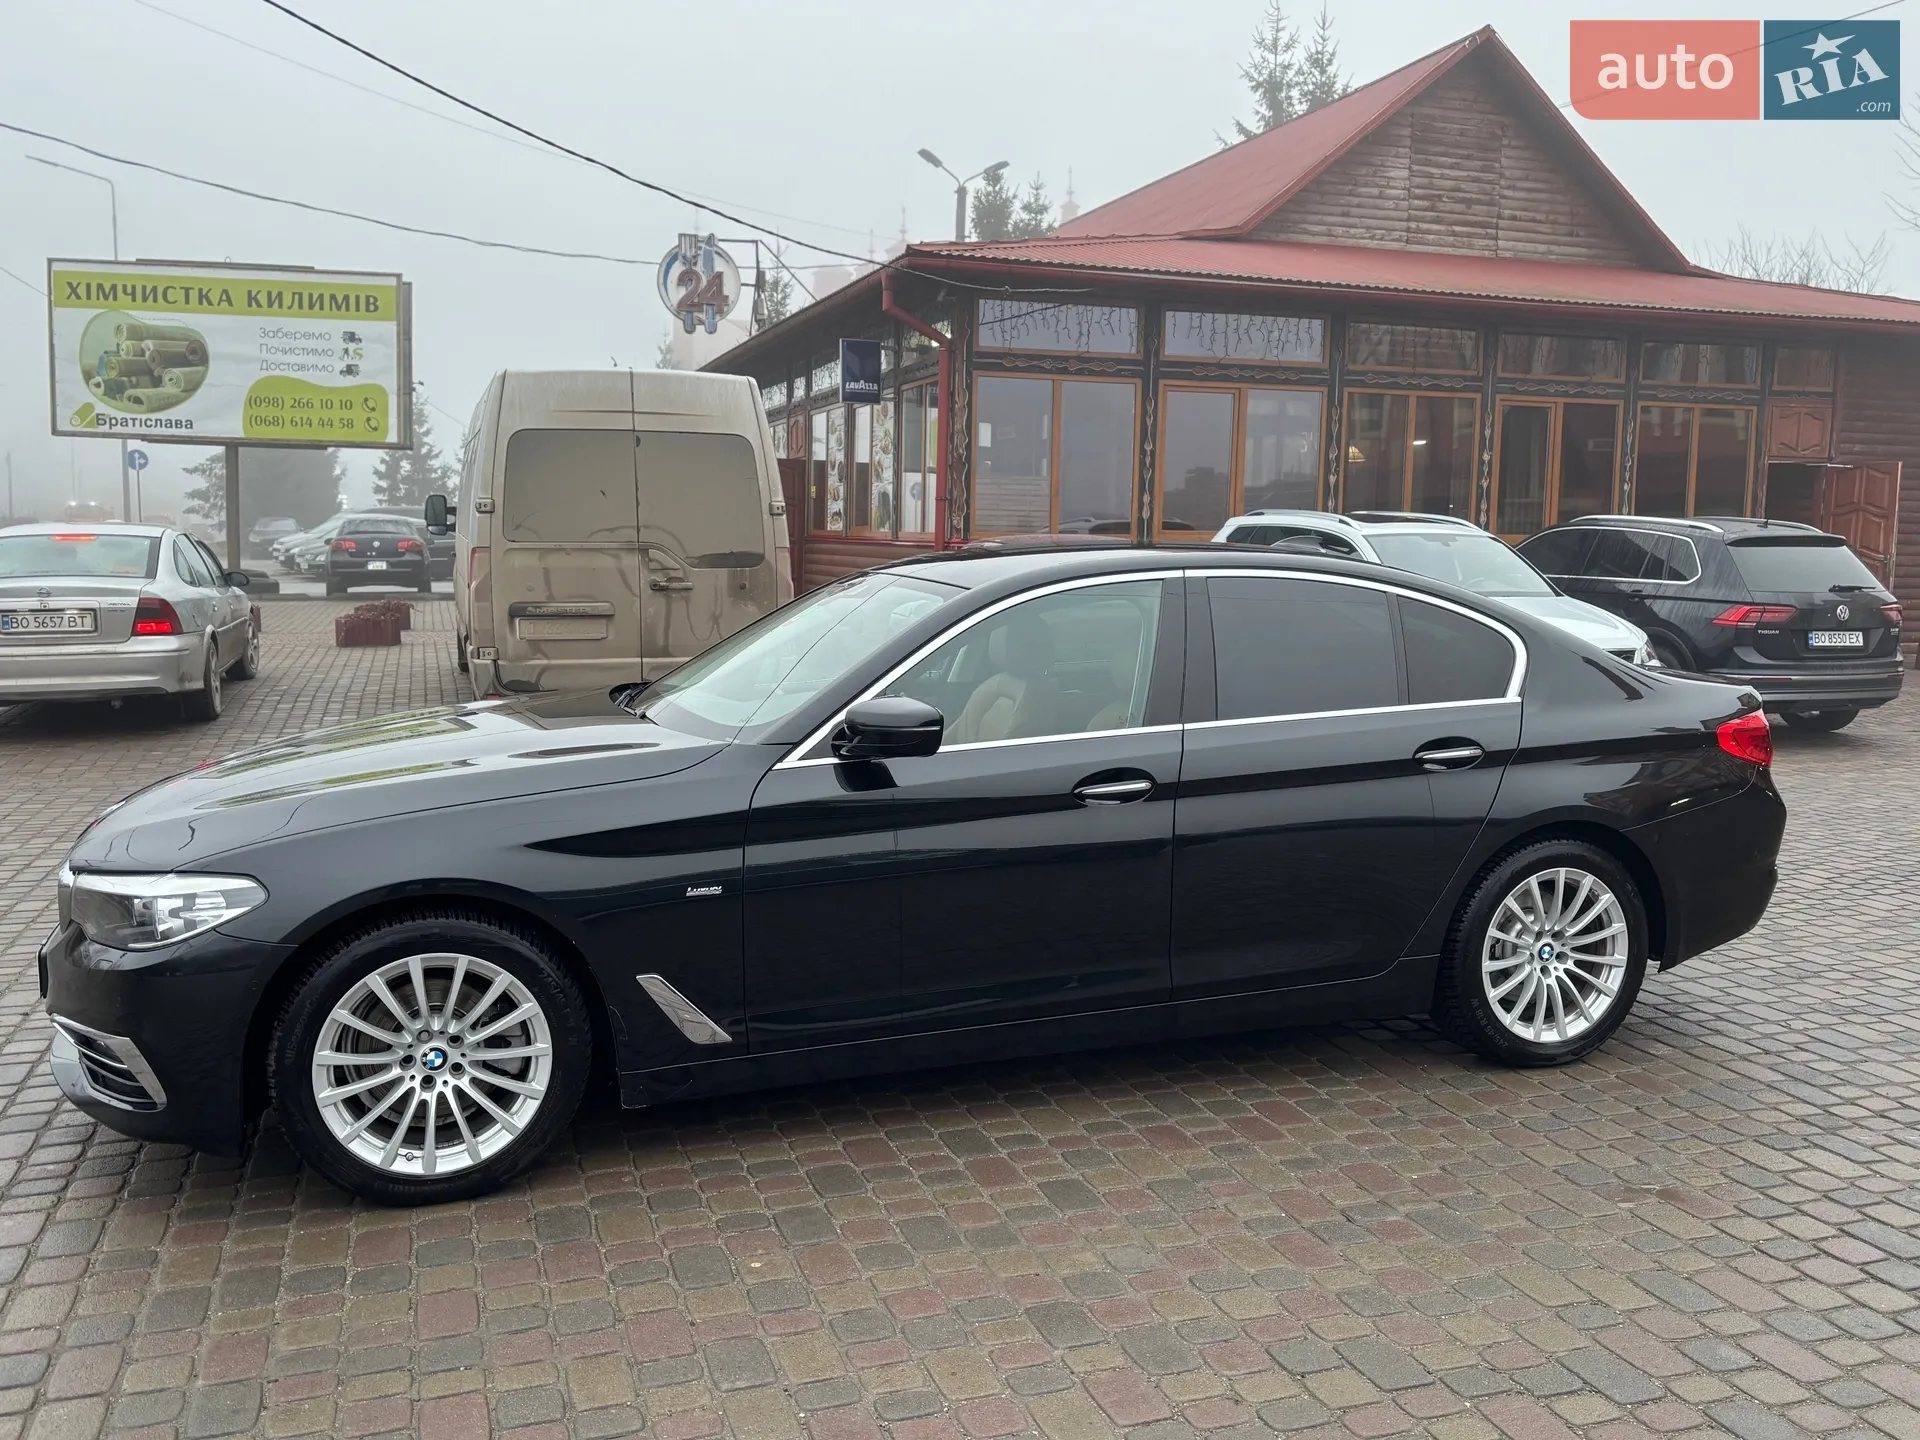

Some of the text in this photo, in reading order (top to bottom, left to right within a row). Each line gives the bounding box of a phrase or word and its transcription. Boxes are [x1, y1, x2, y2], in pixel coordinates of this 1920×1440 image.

[65, 280, 380, 314] ХІМЧИСТКА КИЛИМІВ
[676, 268, 730, 315] 24
[258, 326, 332, 342] Заберемо
[259, 342, 335, 358] Почистимо
[259, 359, 335, 374] Доставимо
[845, 379, 878, 390] LAVAZZA
[248, 394, 354, 411] (098) 266 10 10
[95, 412, 195, 431] Братіслава
[248, 413, 355, 430] (068) 614 44 58
[33, 616, 65, 629] 5657
[1827, 632, 1847, 644] 8550
